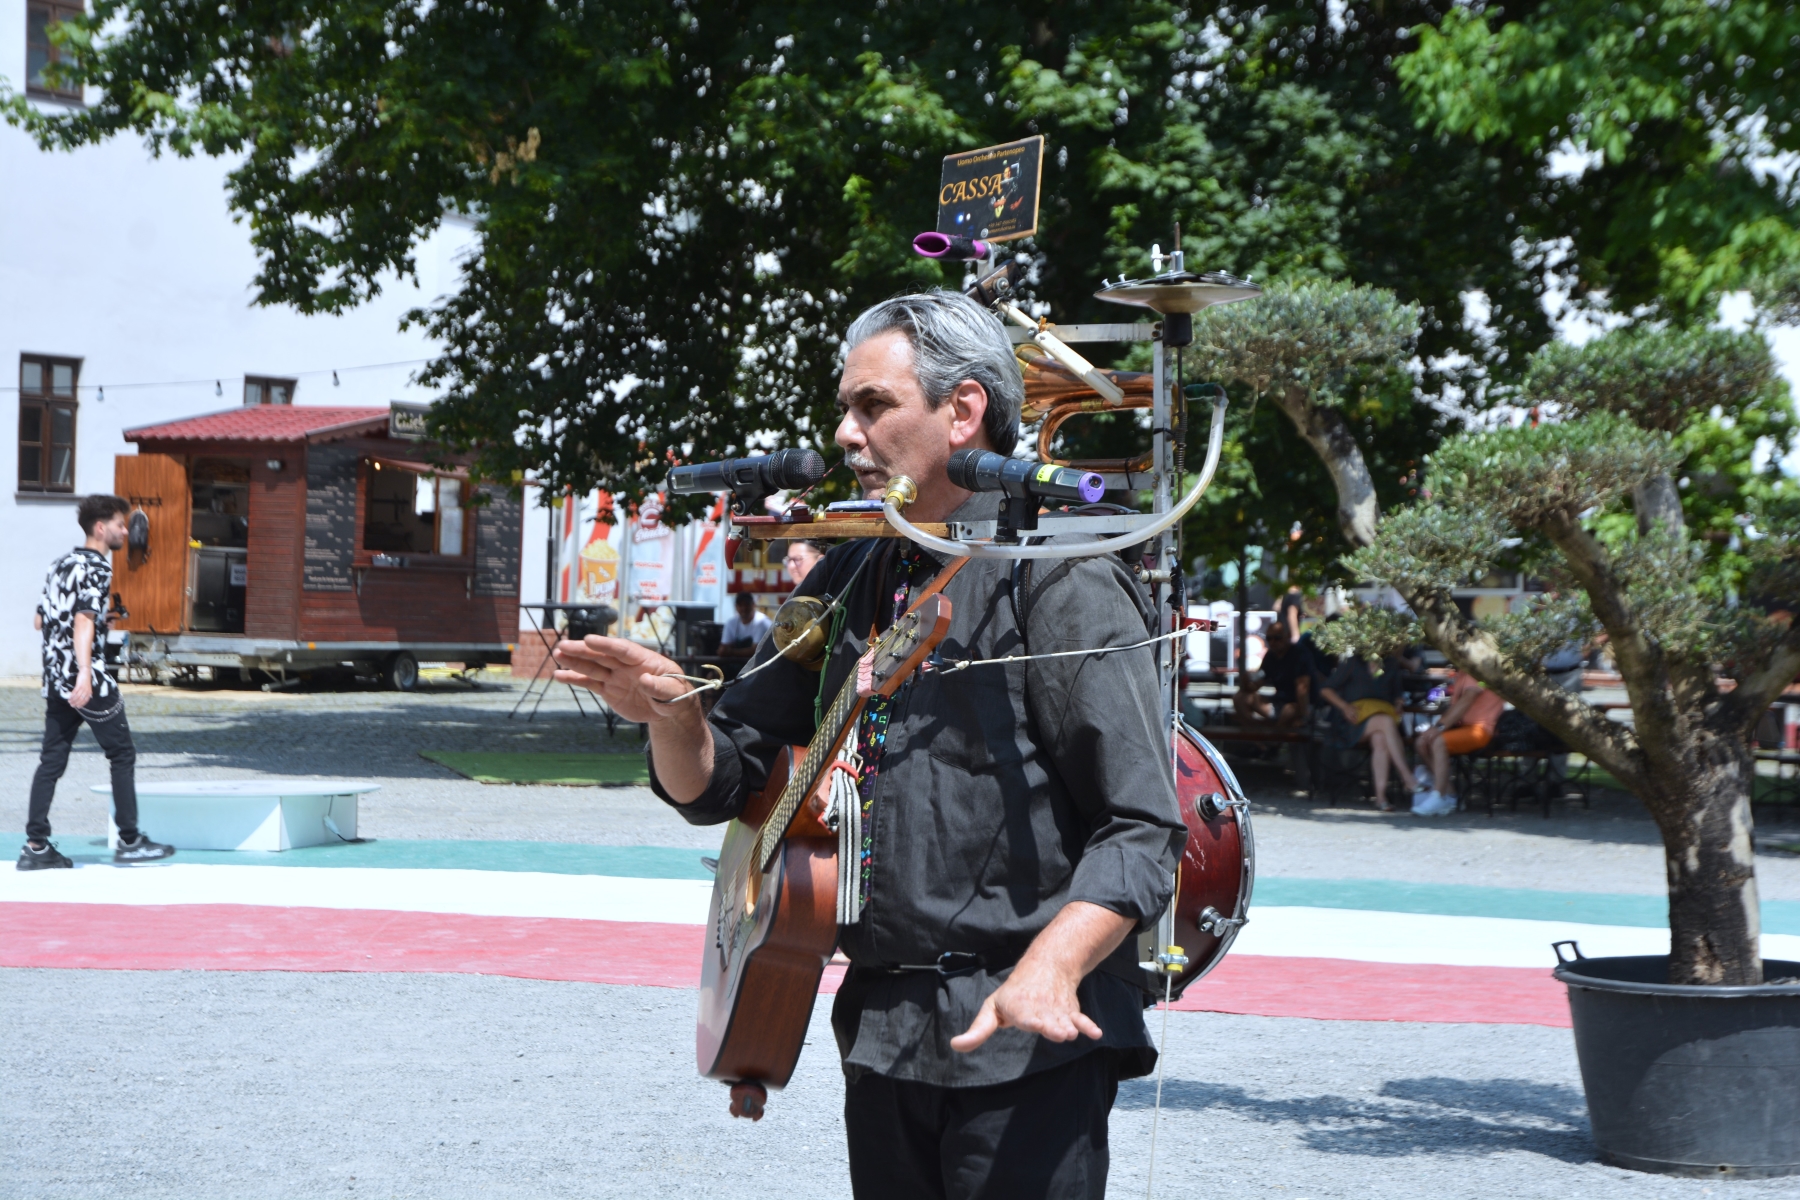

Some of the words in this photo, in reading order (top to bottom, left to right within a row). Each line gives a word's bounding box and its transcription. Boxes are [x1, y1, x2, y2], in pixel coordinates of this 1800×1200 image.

[957, 158, 973, 166] Uomo
[973, 152, 996, 163] Orchesa
[997, 147, 1025, 157] Partenopeo
[940, 173, 1003, 205] CASSA
